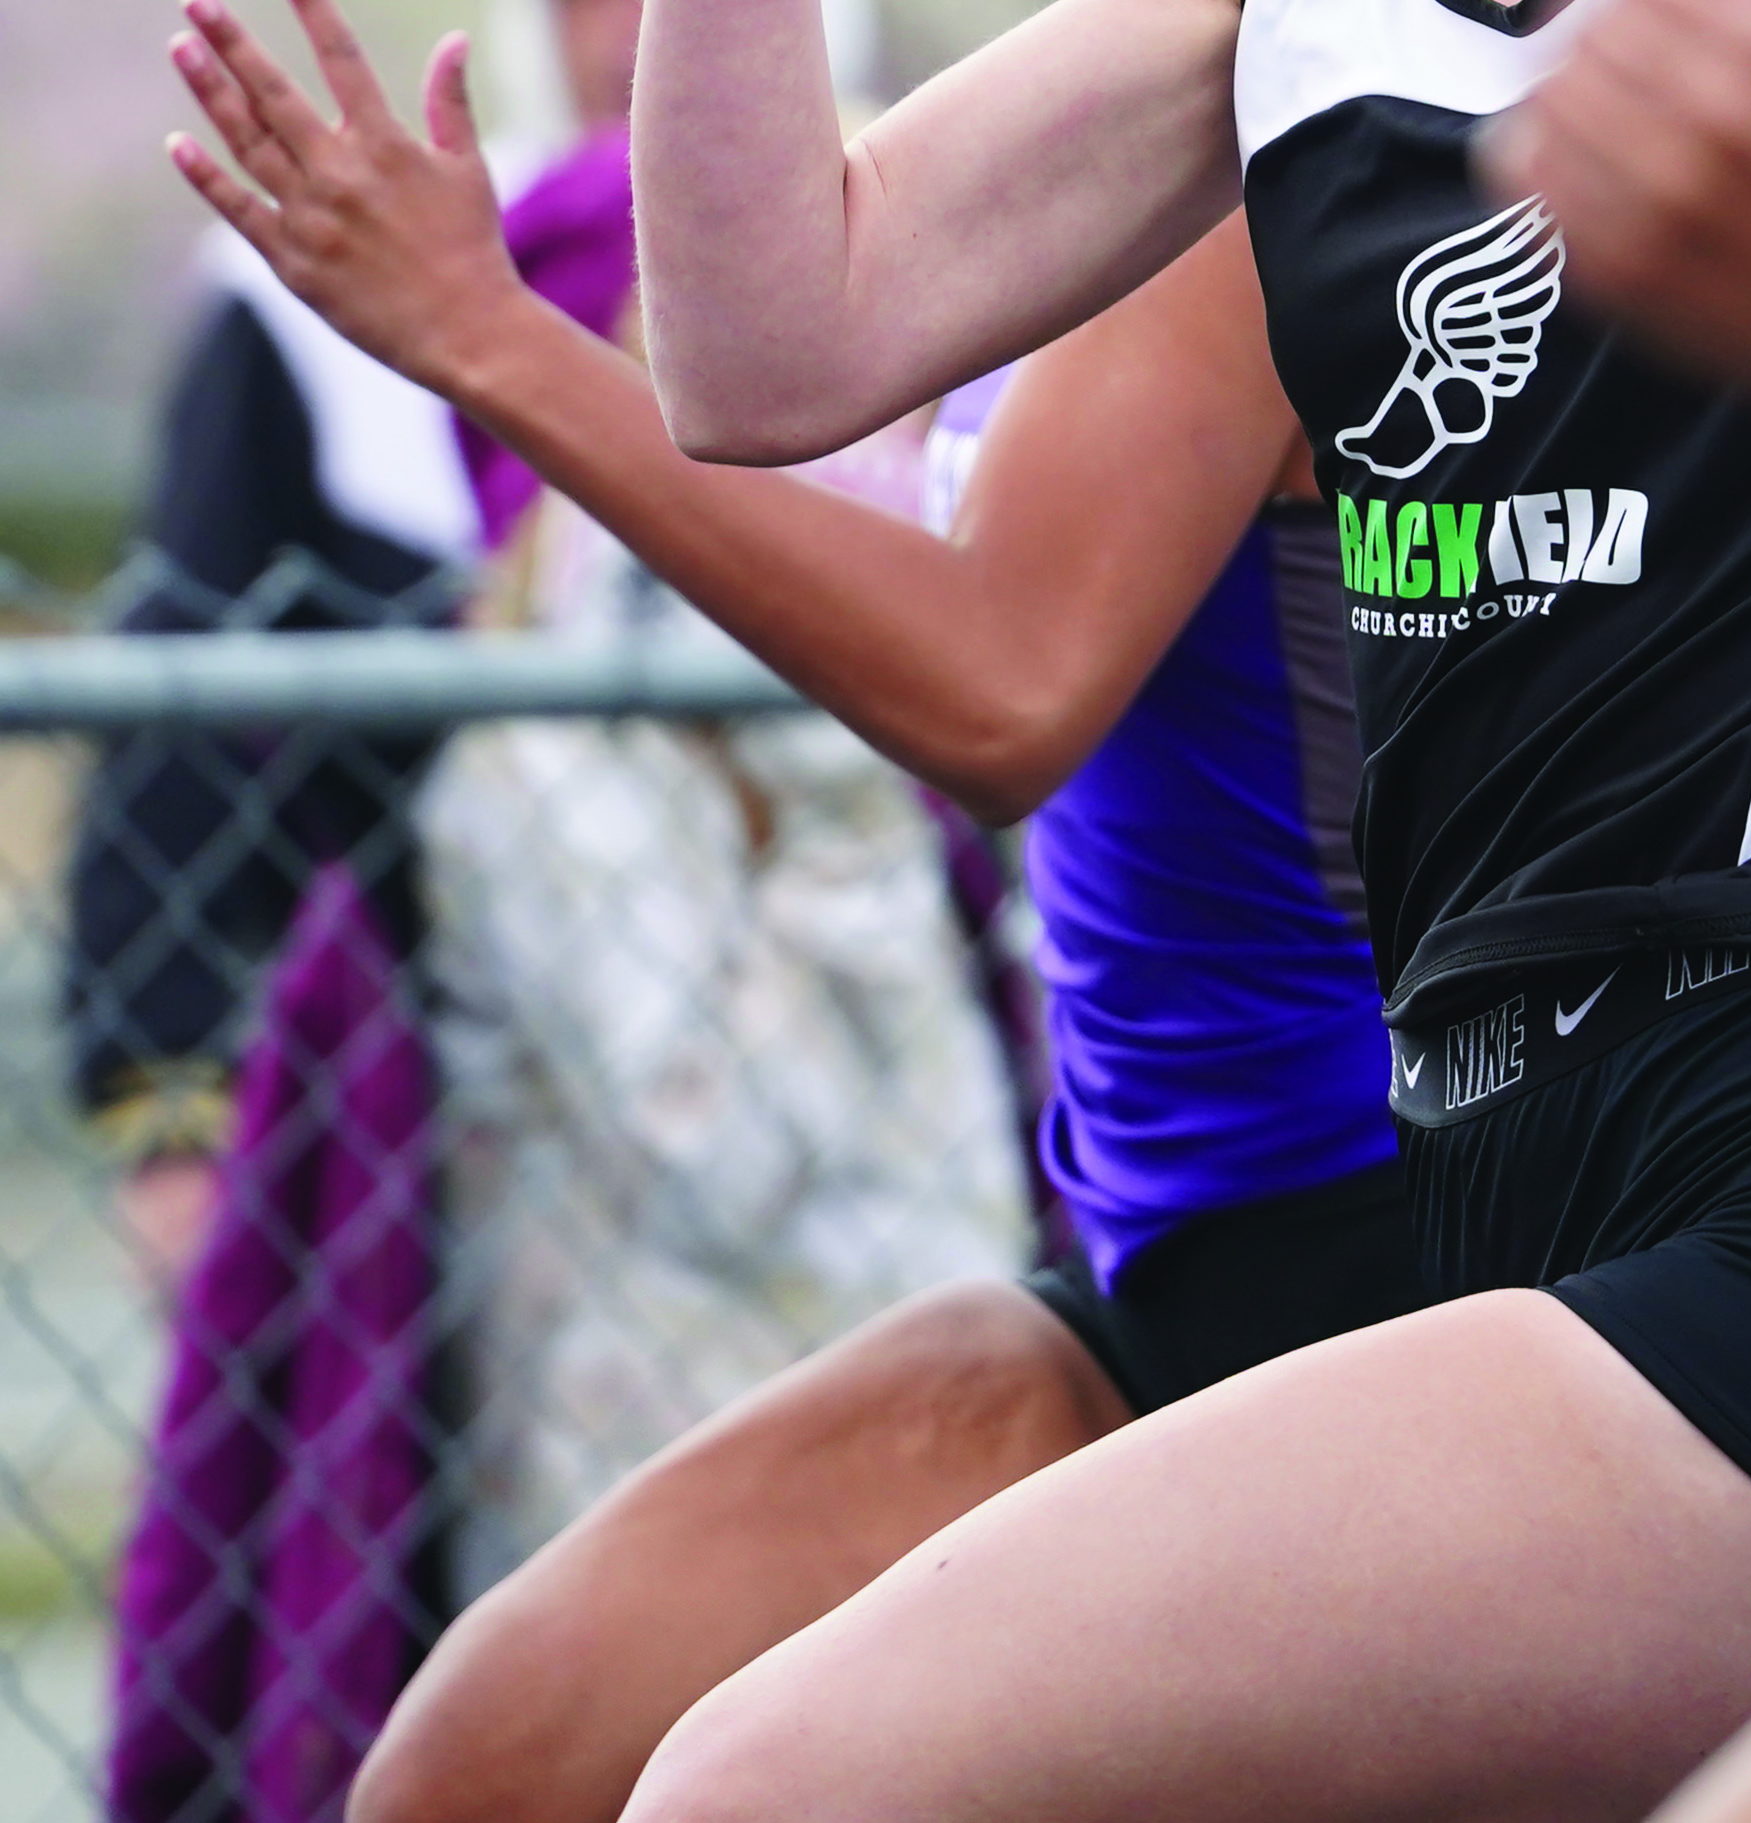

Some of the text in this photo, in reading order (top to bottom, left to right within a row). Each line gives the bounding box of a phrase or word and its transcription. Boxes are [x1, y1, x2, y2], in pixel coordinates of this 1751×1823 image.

[1338, 487, 1483, 599] RACK
[1351, 606, 1454, 639] CHURCHI
[1445, 993, 1525, 1110] NIKE
